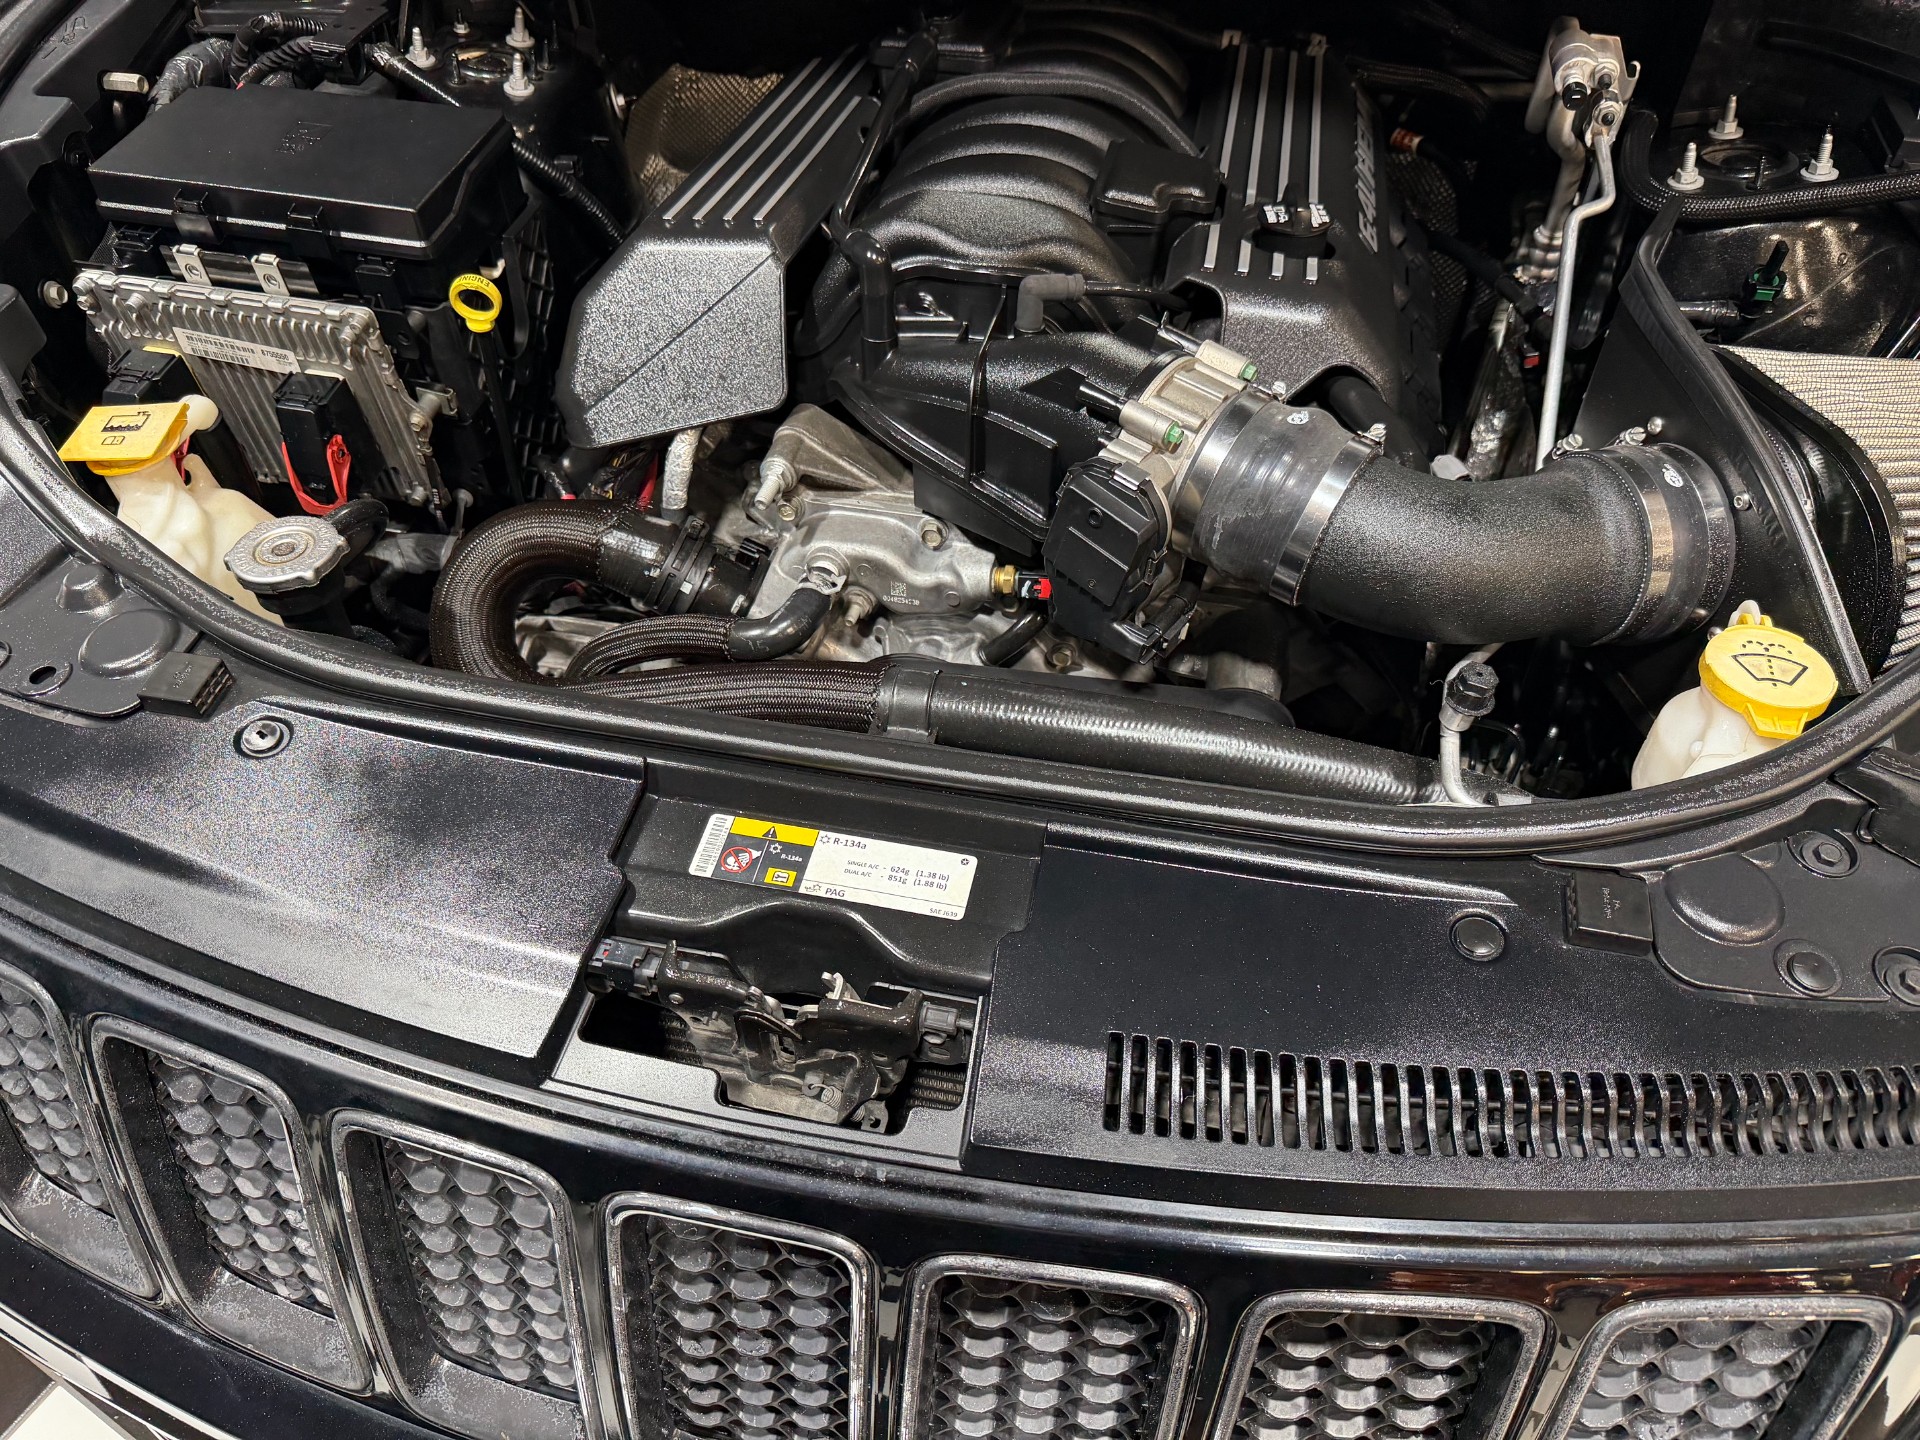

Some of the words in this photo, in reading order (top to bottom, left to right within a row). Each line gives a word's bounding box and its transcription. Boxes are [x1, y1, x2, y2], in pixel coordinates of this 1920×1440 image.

[832, 837, 867, 850] R-134a
[780, 853, 803, 862] R-134a
[847, 859, 868, 868] SINGLE
[868, 862, 880, 870] A/C
[890, 865, 910, 876] 624g
[915, 869, 937, 879] (1.38
[938, 873, 950, 882] lb)
[843, 868, 860, 876] DUAL
[860, 870, 872, 878] A/C
[887, 874, 908, 885] 851g
[913, 877, 935, 888] (1.88
[936, 882, 948, 891] lb)
[824, 887, 846, 898] PAG
[929, 907, 942, 915] SAE
[942, 909, 958, 918] J639
